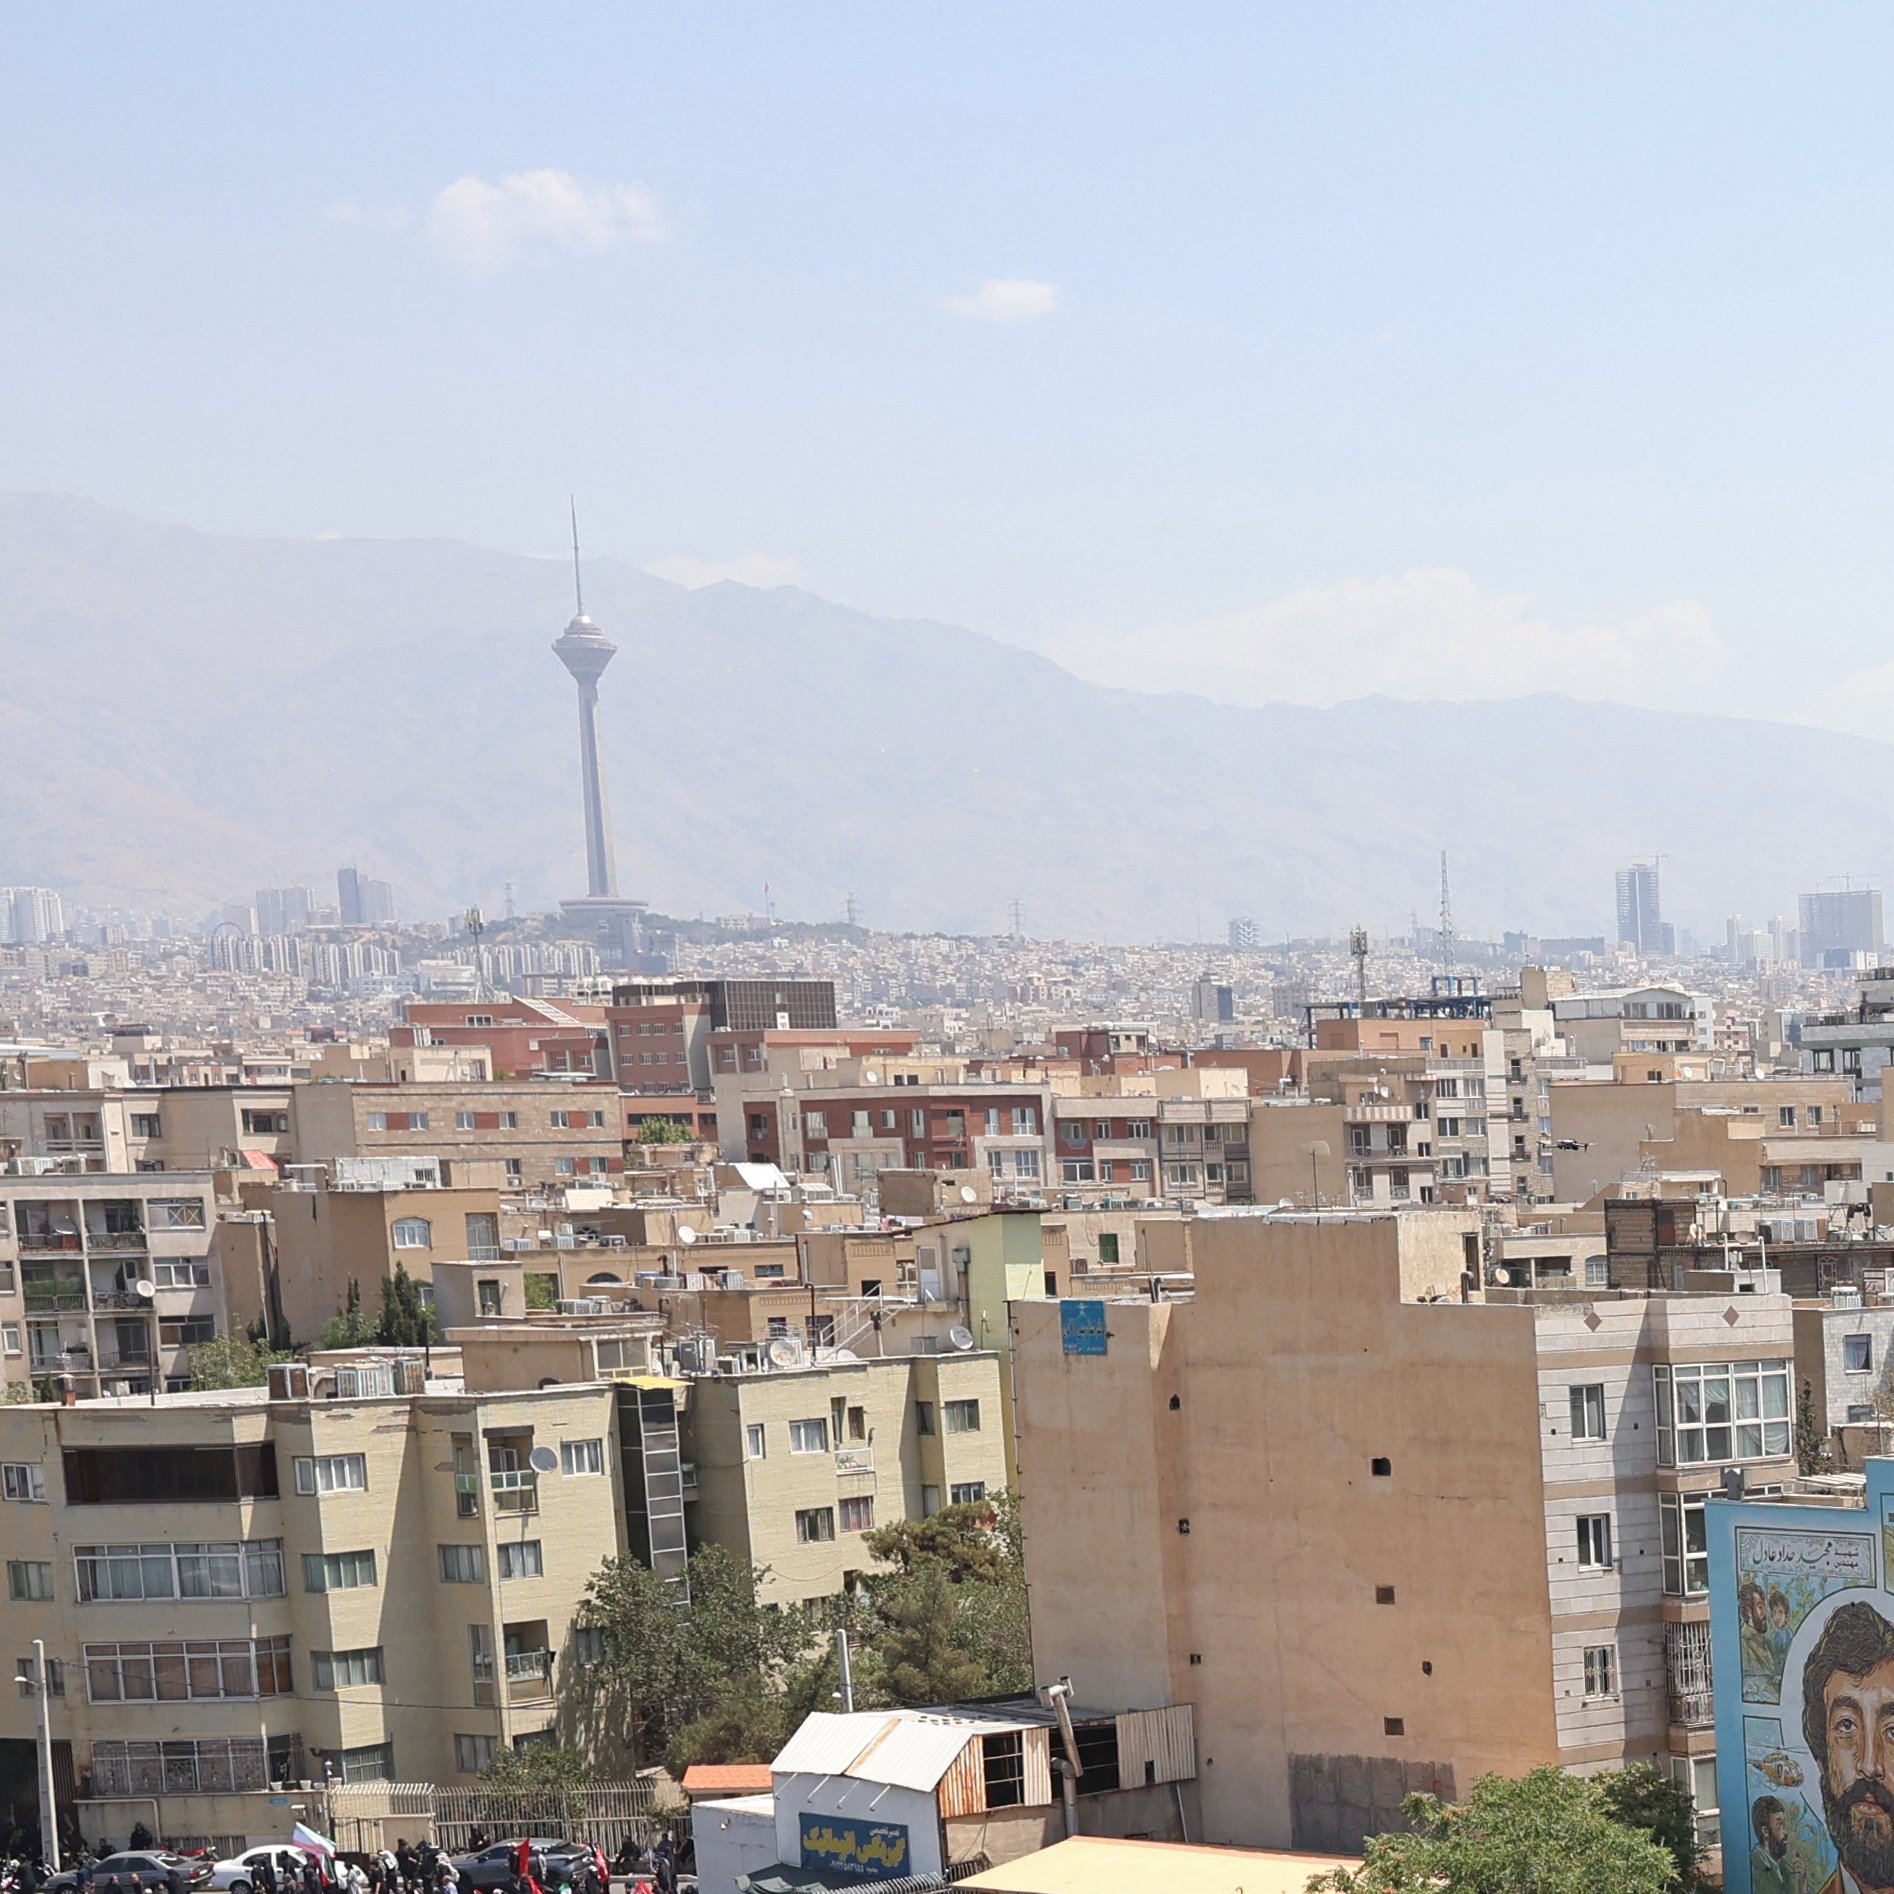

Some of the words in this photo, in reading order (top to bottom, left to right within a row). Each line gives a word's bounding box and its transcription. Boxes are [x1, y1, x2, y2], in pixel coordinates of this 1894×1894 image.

[1752, 1540, 1777, 1565] عادل
[1798, 1541, 1833, 1570] مجید
[1834, 1548, 1860, 1558] شهید
[1834, 1560, 1860, 1569] مهندس
[856, 1834, 906, 1868] گیربکس
